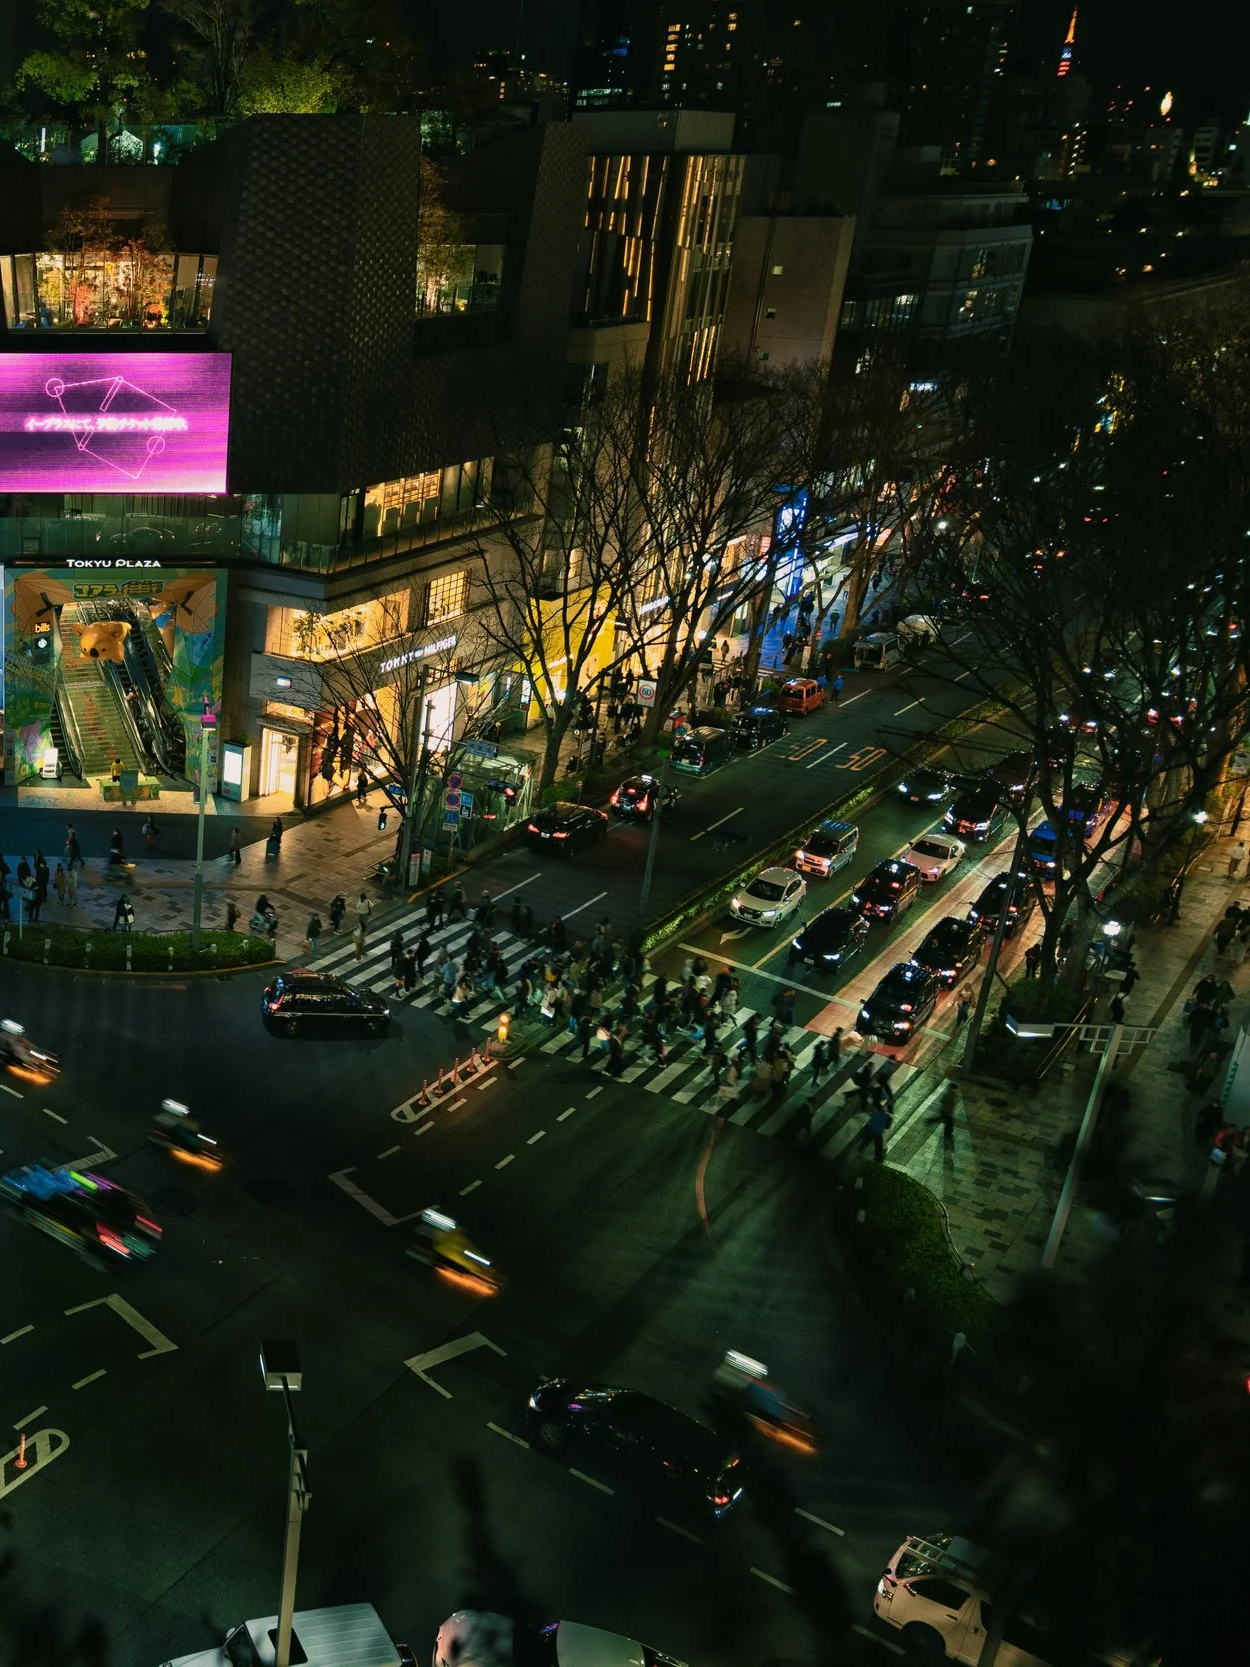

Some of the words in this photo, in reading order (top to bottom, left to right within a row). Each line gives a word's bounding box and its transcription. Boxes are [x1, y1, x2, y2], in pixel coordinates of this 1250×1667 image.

[66, 559, 112, 568] TOKYU
[115, 558, 162, 568] PLAZA
[34, 622, 51, 633] bills
[424, 636, 458, 656] HILFIGER
[835, 745, 888, 771] 50
